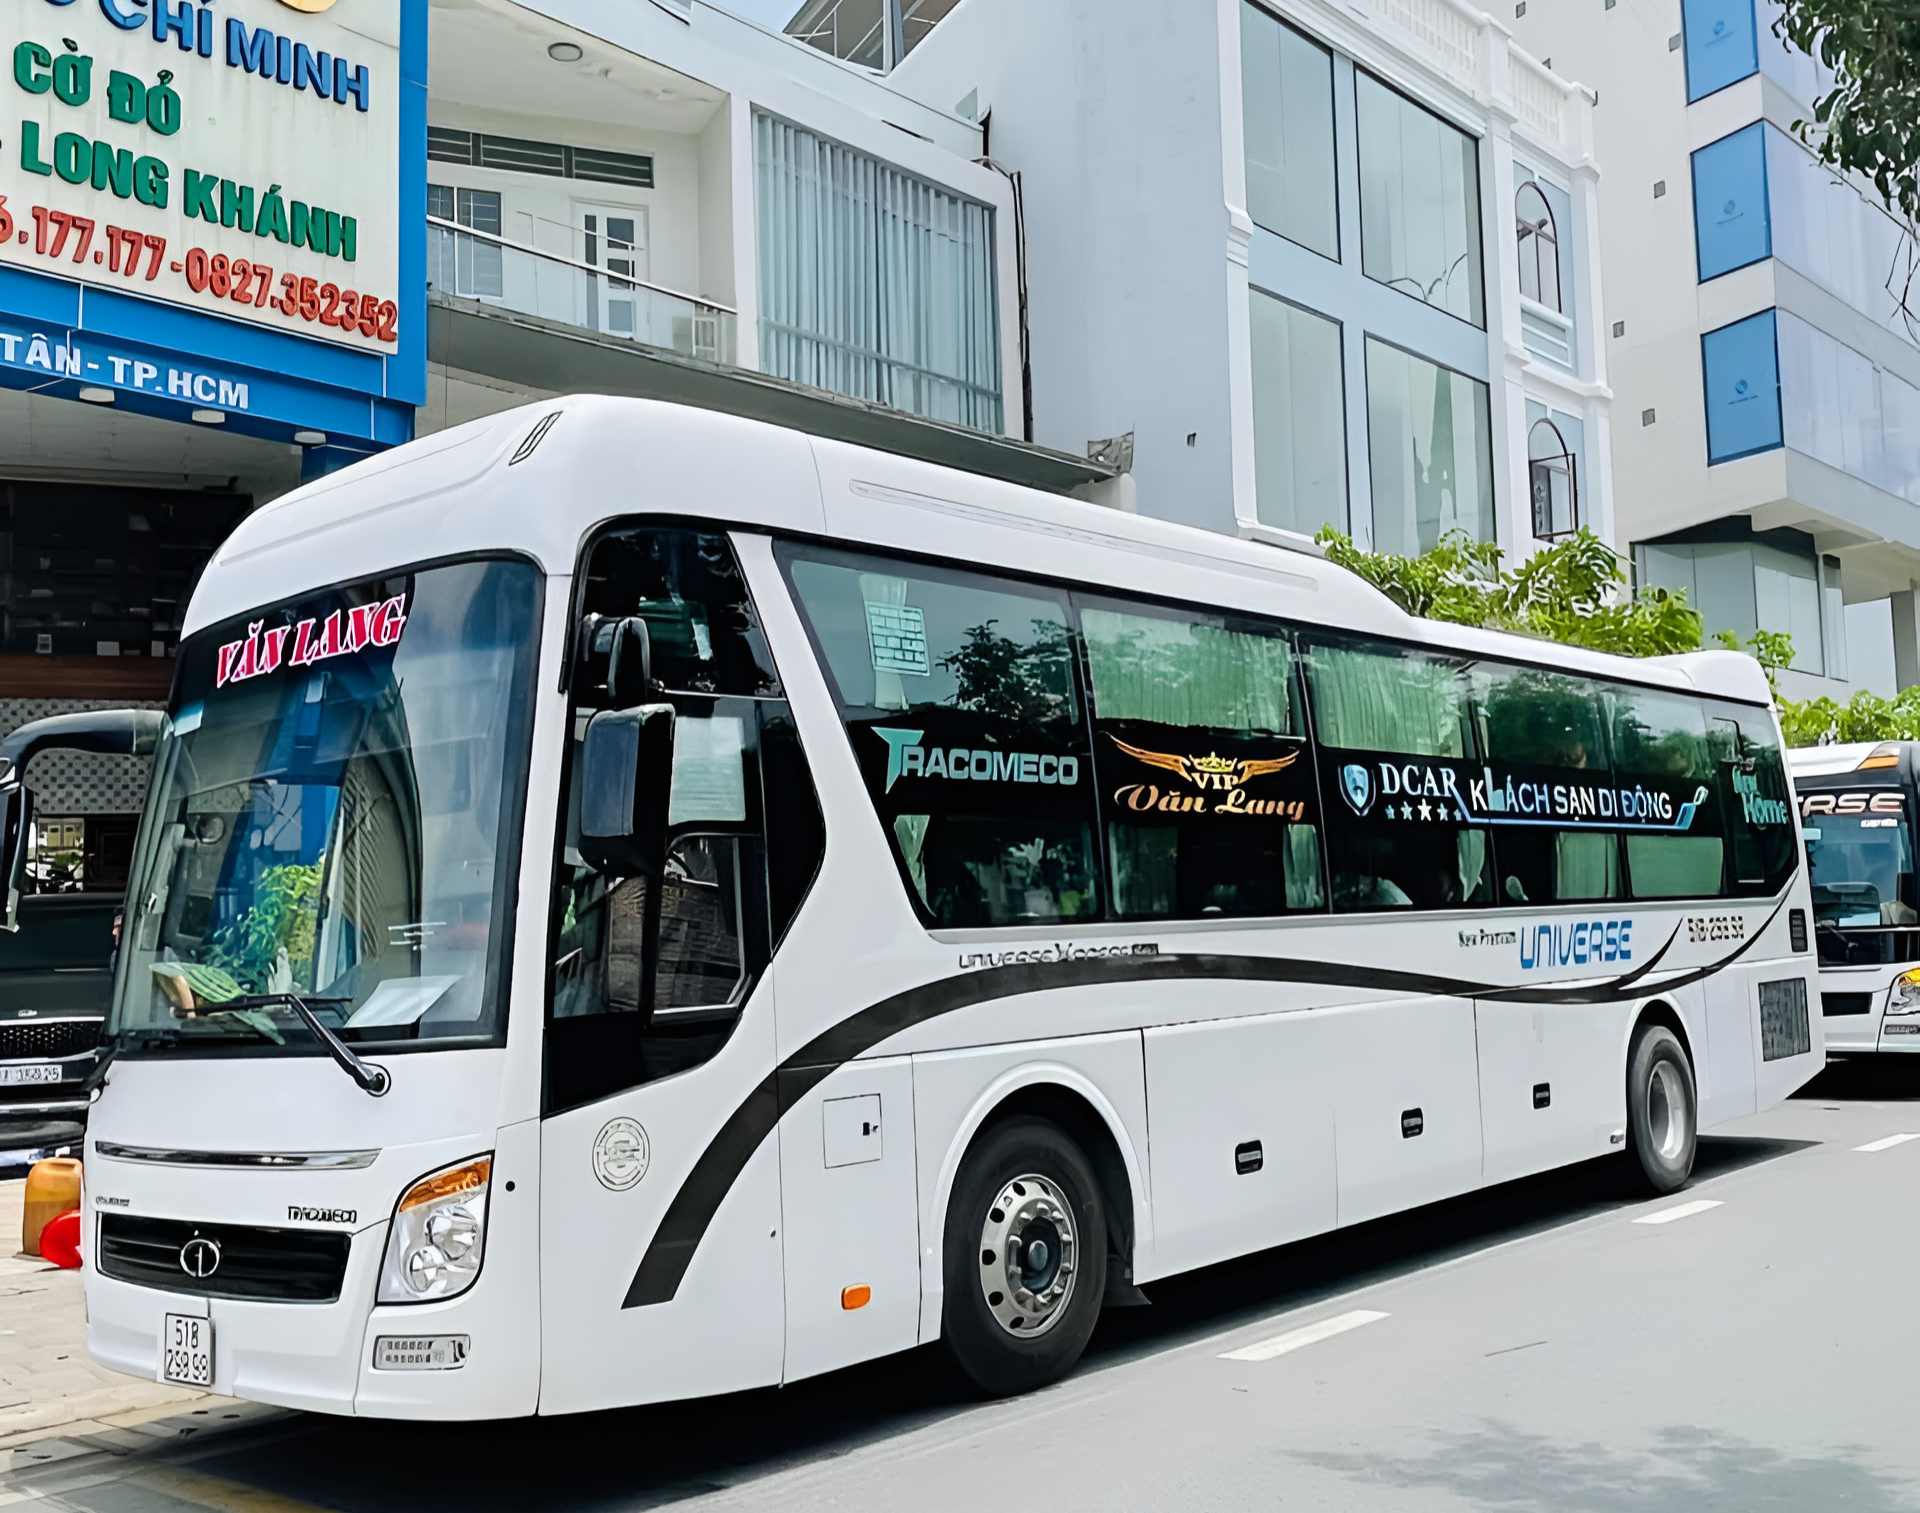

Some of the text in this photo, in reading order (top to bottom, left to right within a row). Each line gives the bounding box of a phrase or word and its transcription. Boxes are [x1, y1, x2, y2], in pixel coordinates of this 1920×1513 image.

[13, 38, 182, 136] CỜ ĐỎ
[226, 18, 369, 112] MINH
[20, 120, 357, 262] LONG KHÁNH
[0, 333, 81, 376] TÂN
[108, 355, 249, 409] TP.HCM
[289, 593, 407, 666] LANG
[871, 726, 1079, 794] TRACOMECO
[1191, 773, 1239, 790] VIP
[1378, 763, 1456, 797] DCAR
[1214, 789, 1305, 821] Lang
[1600, 788, 1619, 817] DI
[1520, 920, 1632, 969] UNIVERSE
